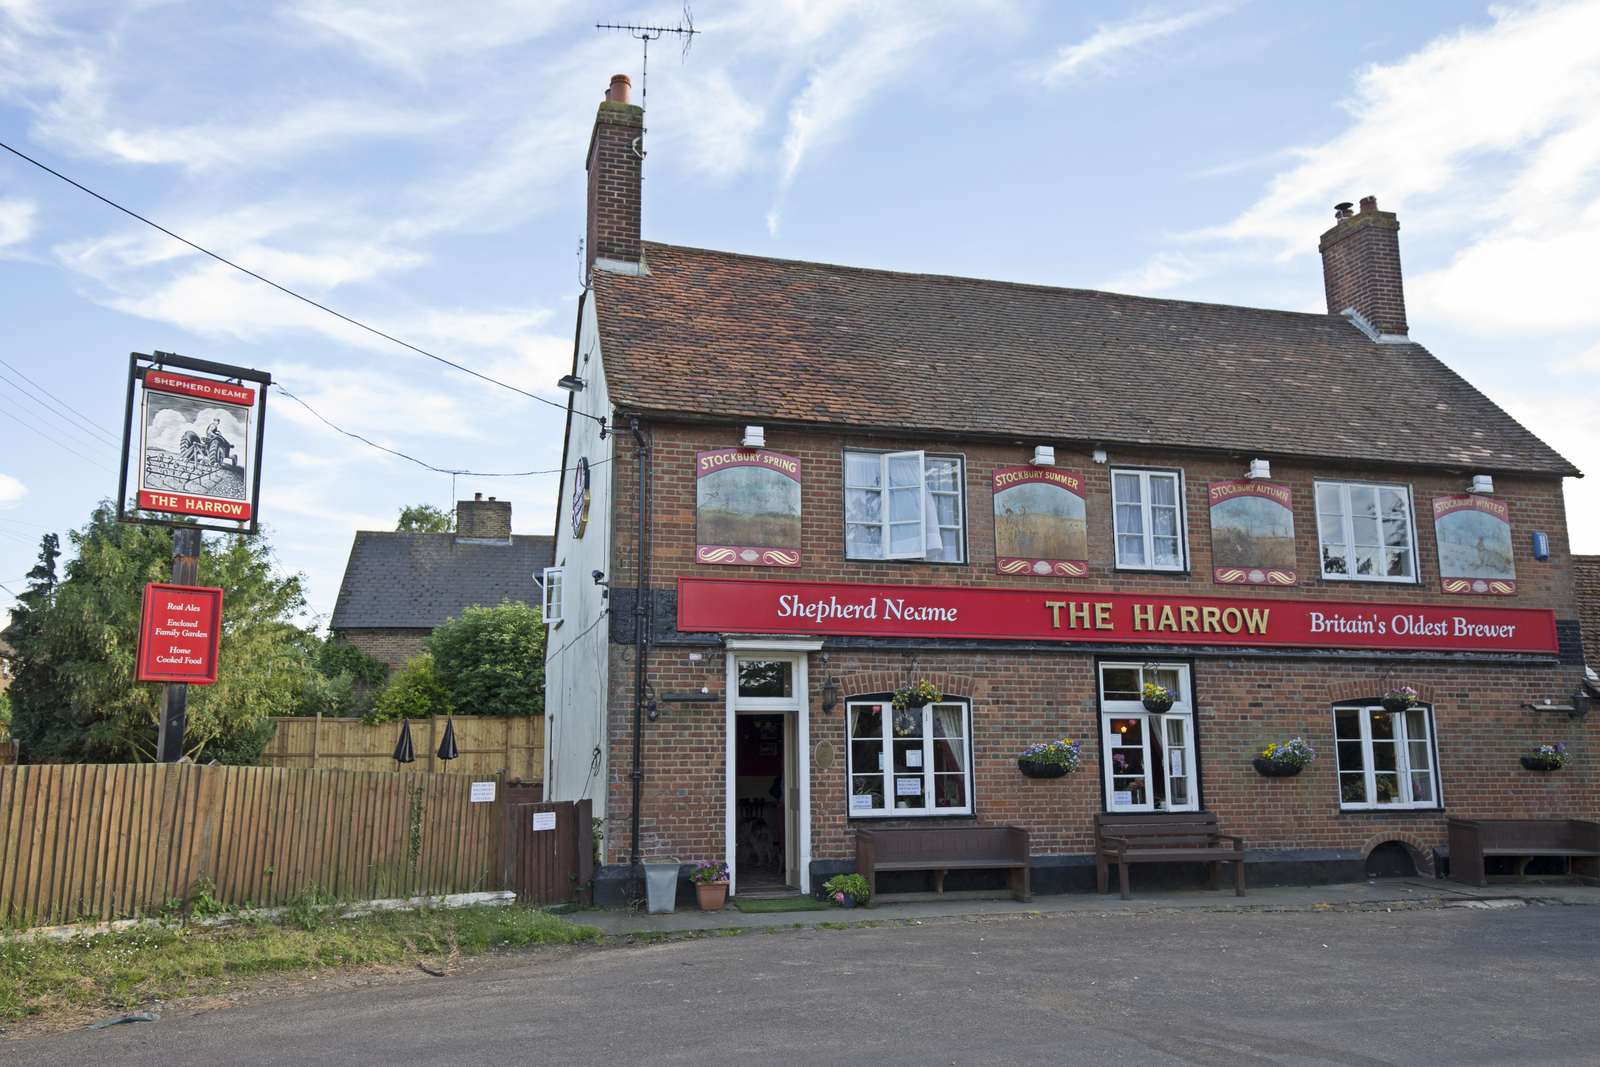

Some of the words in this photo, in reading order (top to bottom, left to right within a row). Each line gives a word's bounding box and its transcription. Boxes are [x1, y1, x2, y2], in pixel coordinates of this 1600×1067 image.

[154, 377, 211, 393] SHEPHERD
[214, 387, 248, 399] NEAME
[701, 453, 761, 469] STOCKBURY
[763, 455, 797, 473] SPRING
[995, 470, 1044, 487] STOCKBURY
[1045, 471, 1079, 490] SUMMER
[1211, 484, 1255, 499] STOCKBURY
[1256, 485, 1289, 502] AUTUMN
[149, 494, 178, 508] THE
[185, 499, 243, 515] HARROW
[1435, 498, 1474, 513] STOCKBURY
[1475, 499, 1505, 516] WINTER
[167, 602, 183, 611] Real
[184, 604, 200, 612] Ales
[777, 594, 877, 623] Shepherd
[883, 598, 958, 622] Neame
[1045, 600, 1114, 630] THE
[1132, 604, 1270, 635] HARROW
[1309, 611, 1386, 635] Britain's
[1391, 614, 1448, 636] Oldest
[1452, 617, 1516, 638] Brewer
[167, 619, 198, 628] Enclosed
[155, 628, 180, 637] Family
[181, 629, 208, 638] Garden
[169, 646, 191, 654] Home
[156, 655, 183, 664] Cooked
[184, 656, 202, 664] Food
